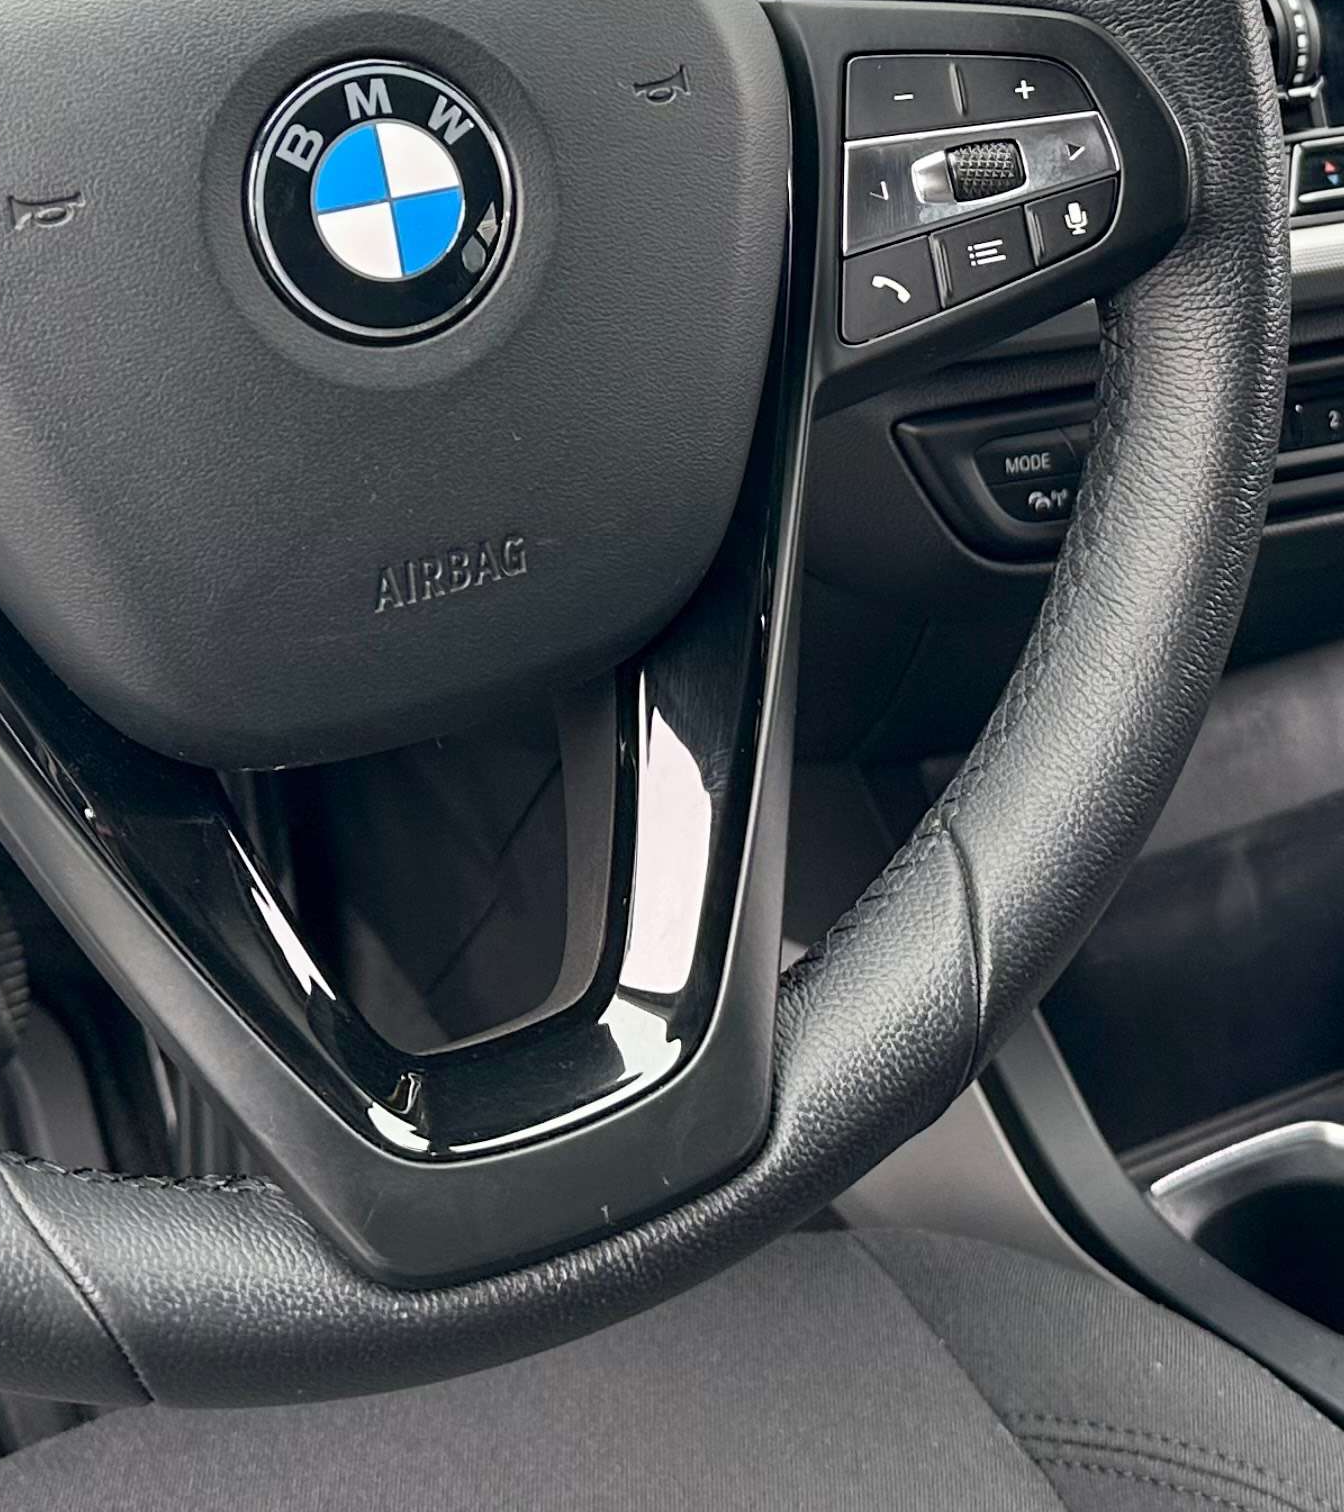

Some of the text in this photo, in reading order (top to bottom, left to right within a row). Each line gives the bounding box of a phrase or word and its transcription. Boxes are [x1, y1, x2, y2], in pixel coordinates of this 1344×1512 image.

[275, 77, 475, 173] BMW
[1328, 409, 1344, 430] 2
[1006, 453, 1051, 474] MODE
[374, 537, 528, 613] AIRBAG
